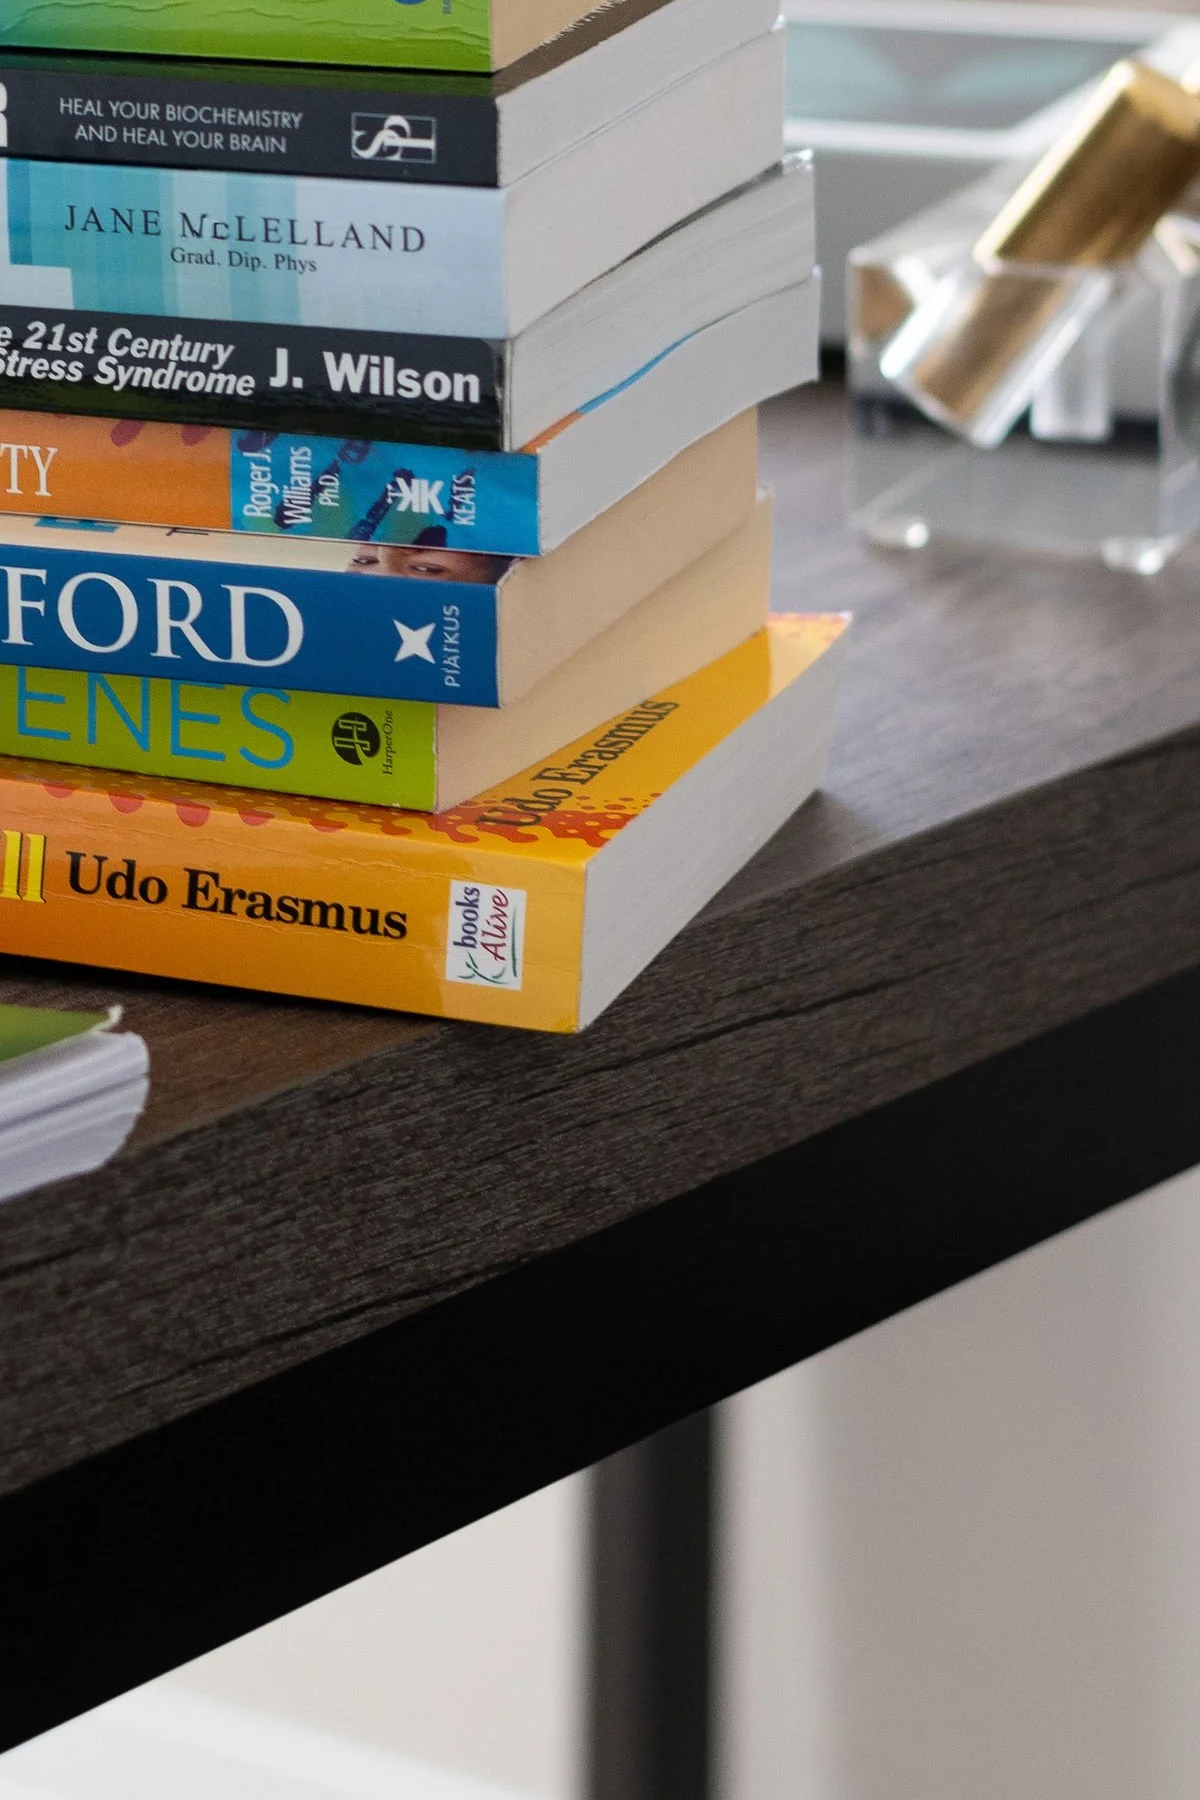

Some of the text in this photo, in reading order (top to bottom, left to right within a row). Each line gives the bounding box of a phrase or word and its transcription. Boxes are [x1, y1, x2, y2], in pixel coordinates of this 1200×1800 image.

[60, 97, 302, 130] HEAL YOUR BIOCHEMISTRY
[76, 124, 286, 153] AND HEAL YOUR BRAIN
[64, 205, 426, 252] JANE McLELLAND
[171, 247, 317, 276] Grad. Dip. Phys
[23, 322, 98, 354] 21st
[108, 328, 234, 364] Century
[94, 357, 254, 397] Syndrome
[270, 348, 479, 402] J. Wilson
[243, 463, 279, 518] Roger
[284, 446, 312, 524] Williams
[453, 468, 475, 525] KEATS
[443, 605, 460, 688] PIATKUS
[382, 710, 393, 776] HarperOne
[475, 700, 680, 828] Udo Erasmus
[69, 852, 407, 940] Udo Erasmus
[452, 886, 480, 948] books
[480, 889, 508, 961] Alive
